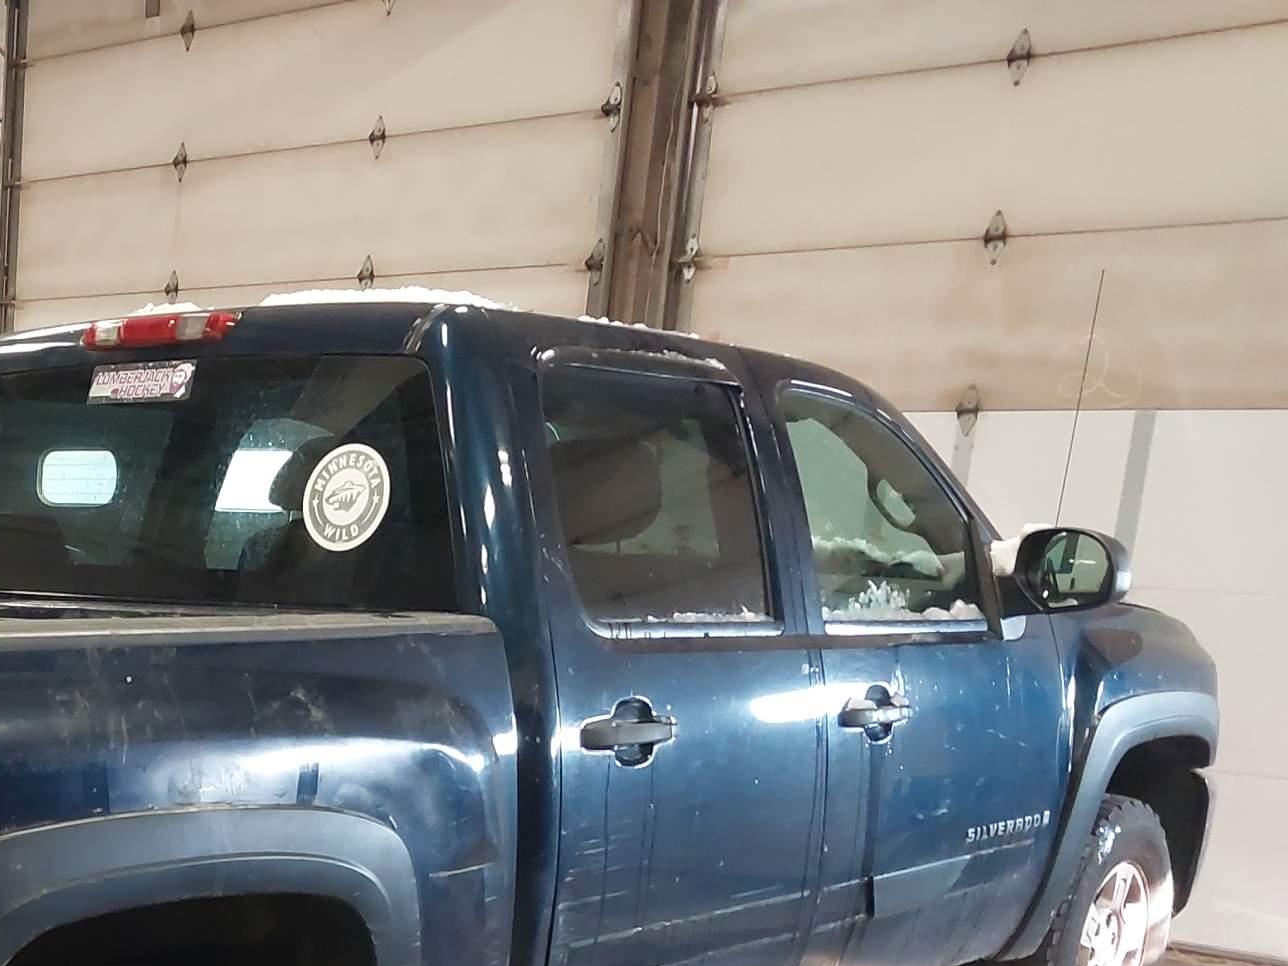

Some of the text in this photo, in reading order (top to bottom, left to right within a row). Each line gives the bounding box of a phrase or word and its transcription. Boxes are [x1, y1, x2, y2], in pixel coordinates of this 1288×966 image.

[96, 367, 172, 385] LUMBERJACK
[118, 383, 166, 398] HOCKEY
[314, 453, 382, 492] MINNESOTA
[323, 523, 359, 541] WILD
[965, 813, 1042, 843] SILVERADO
